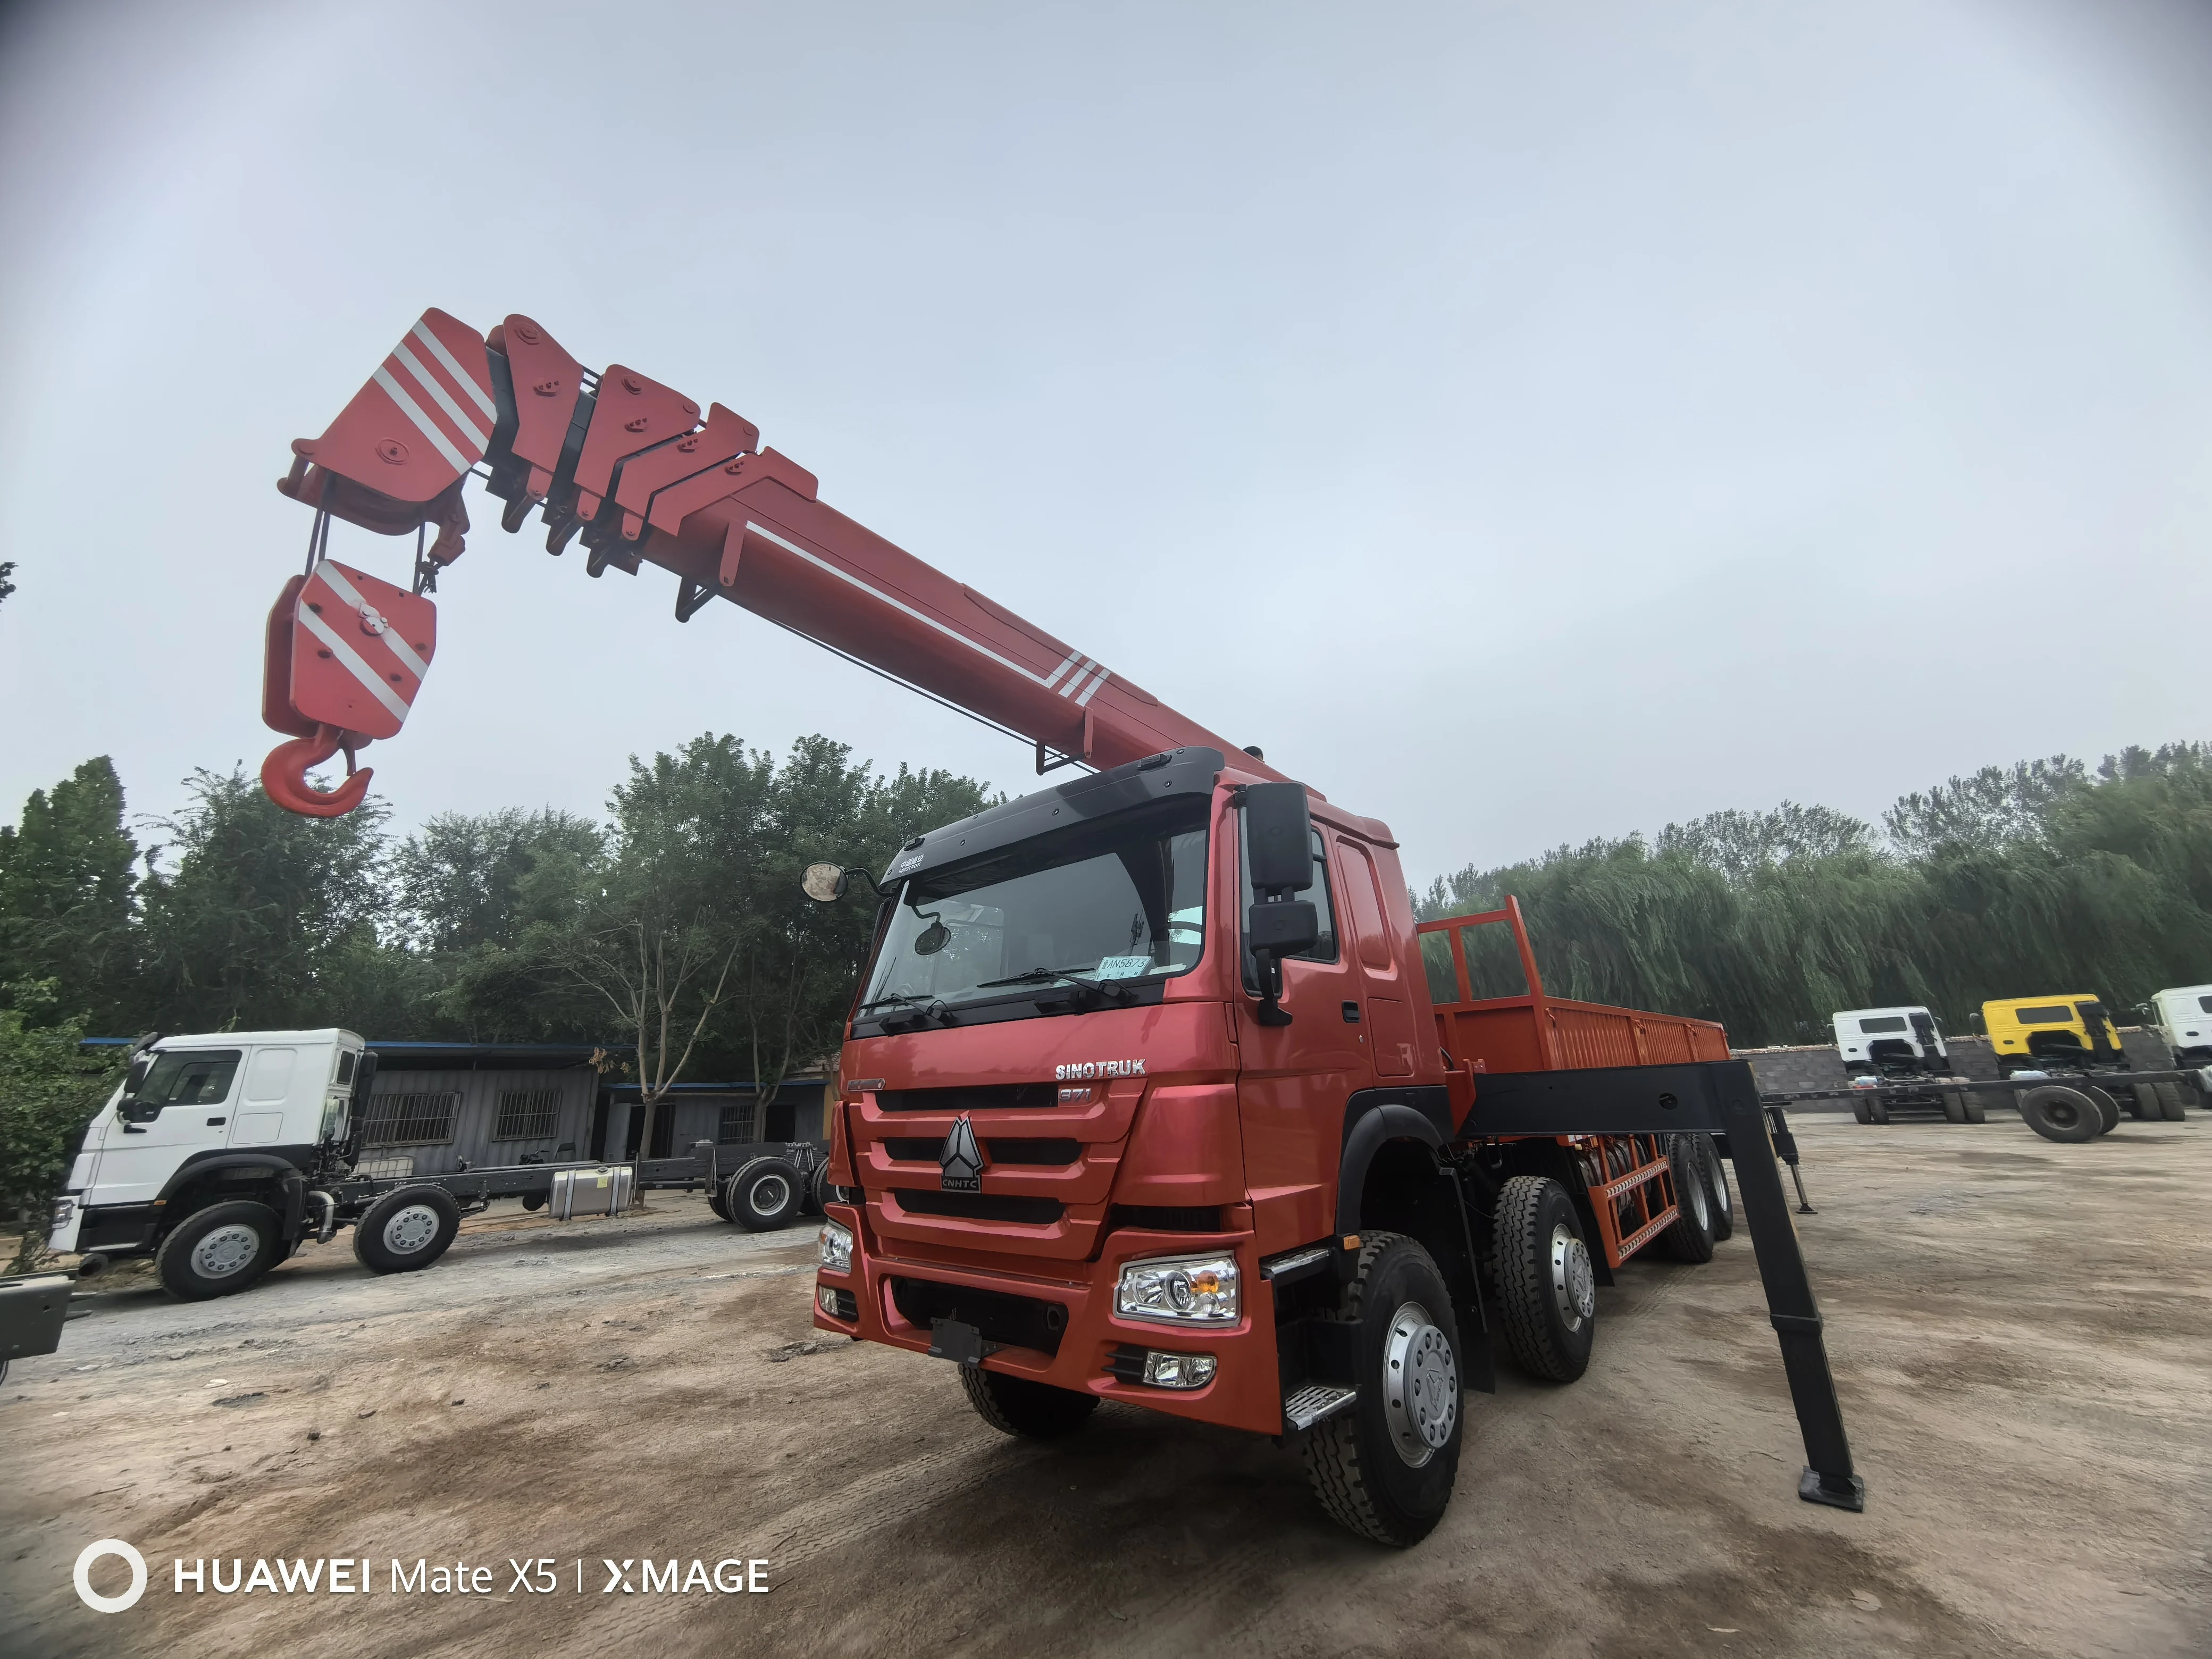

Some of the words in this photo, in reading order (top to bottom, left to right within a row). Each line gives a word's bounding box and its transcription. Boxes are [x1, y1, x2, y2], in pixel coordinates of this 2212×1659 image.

[898, 862, 921, 874] SINOTRUK
[1055, 1059, 1146, 1080] SINOTRUK
[942, 1179, 977, 1188] CNHTC
